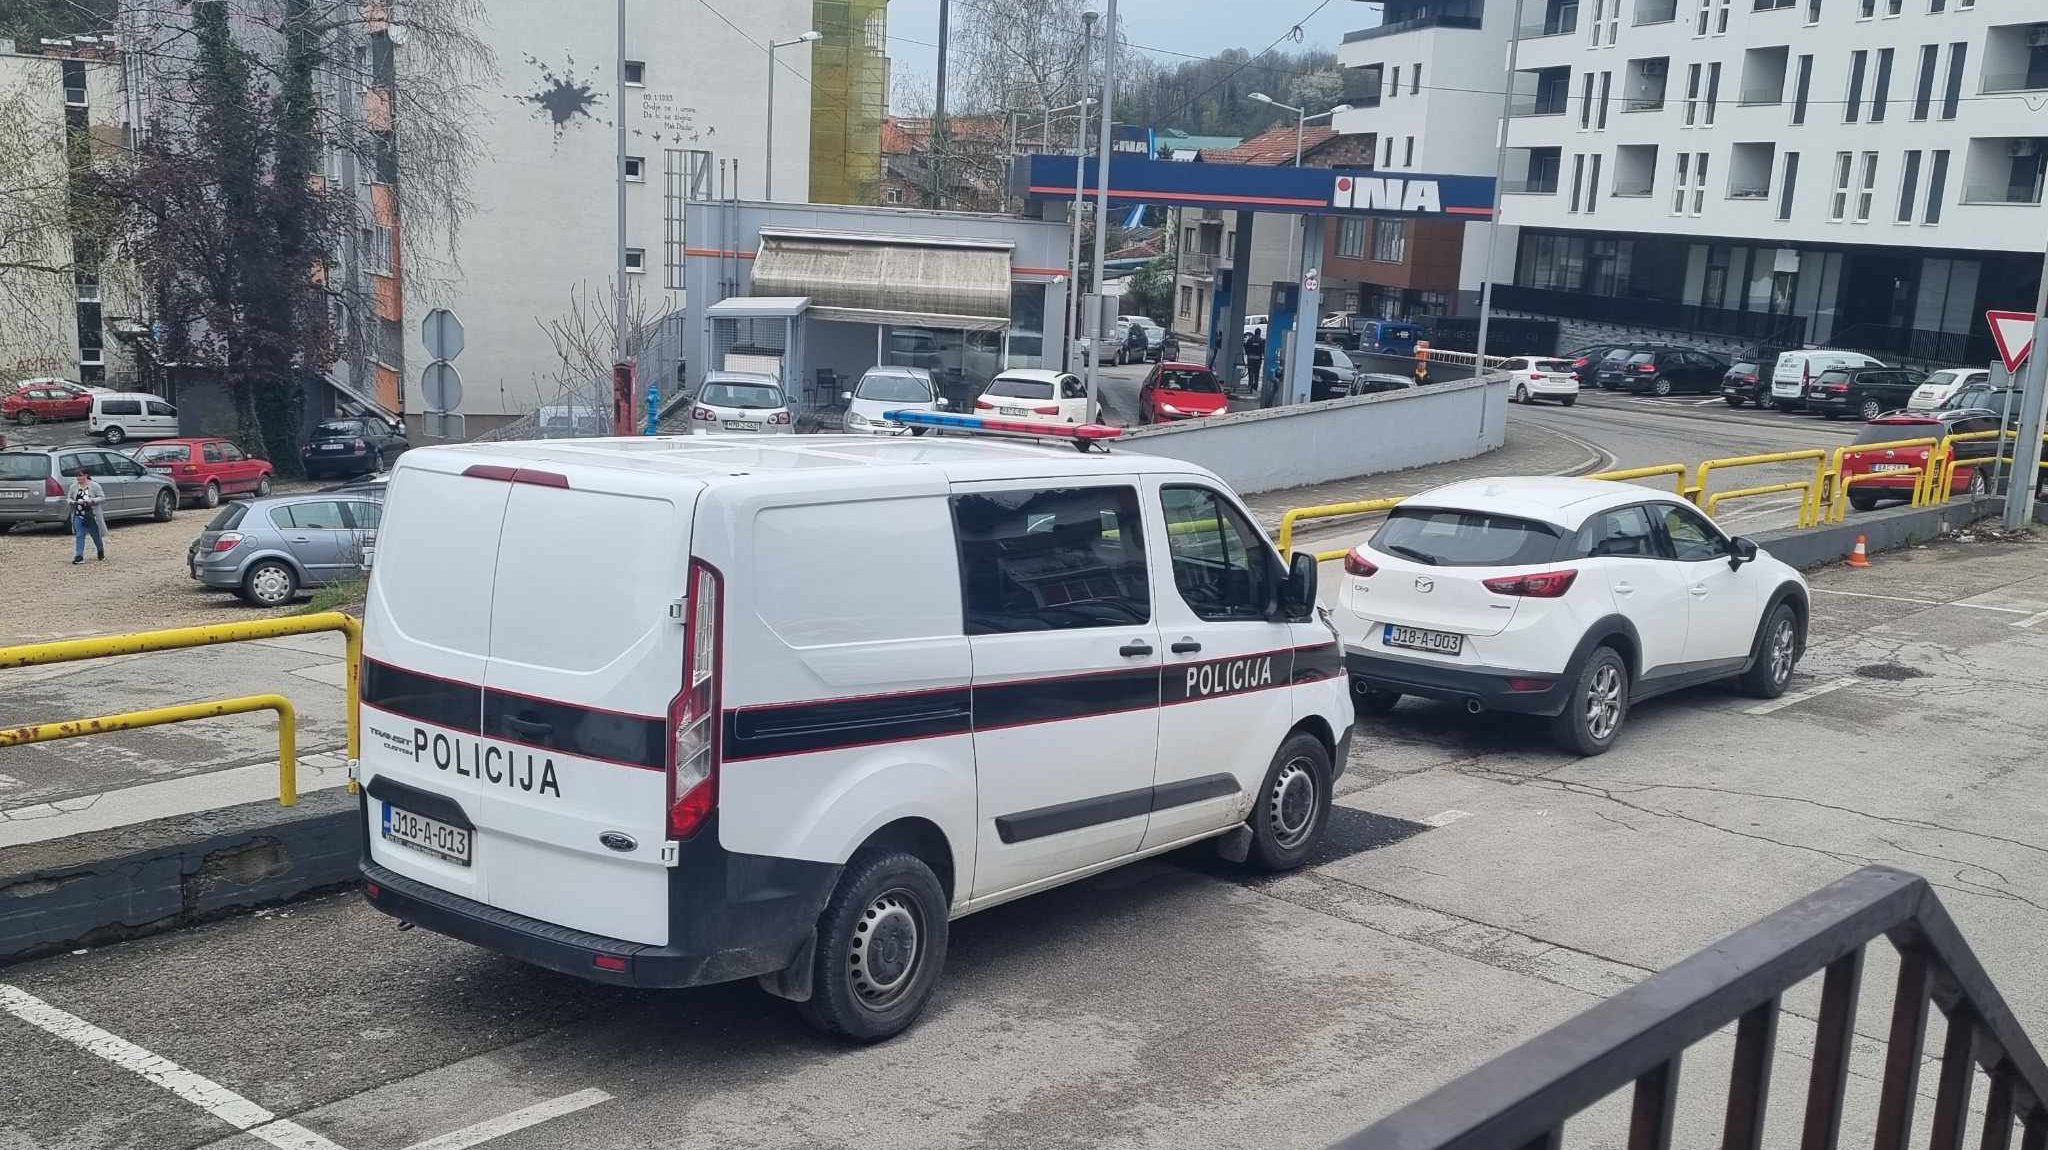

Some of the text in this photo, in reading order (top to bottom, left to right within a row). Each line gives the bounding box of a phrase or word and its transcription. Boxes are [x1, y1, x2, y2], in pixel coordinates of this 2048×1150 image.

[1392, 628, 1458, 650] J18-A-003
[1186, 656, 1271, 697] POLICIJA
[414, 727, 561, 798] POLICIJA
[393, 811, 465, 855] J18-A-013
